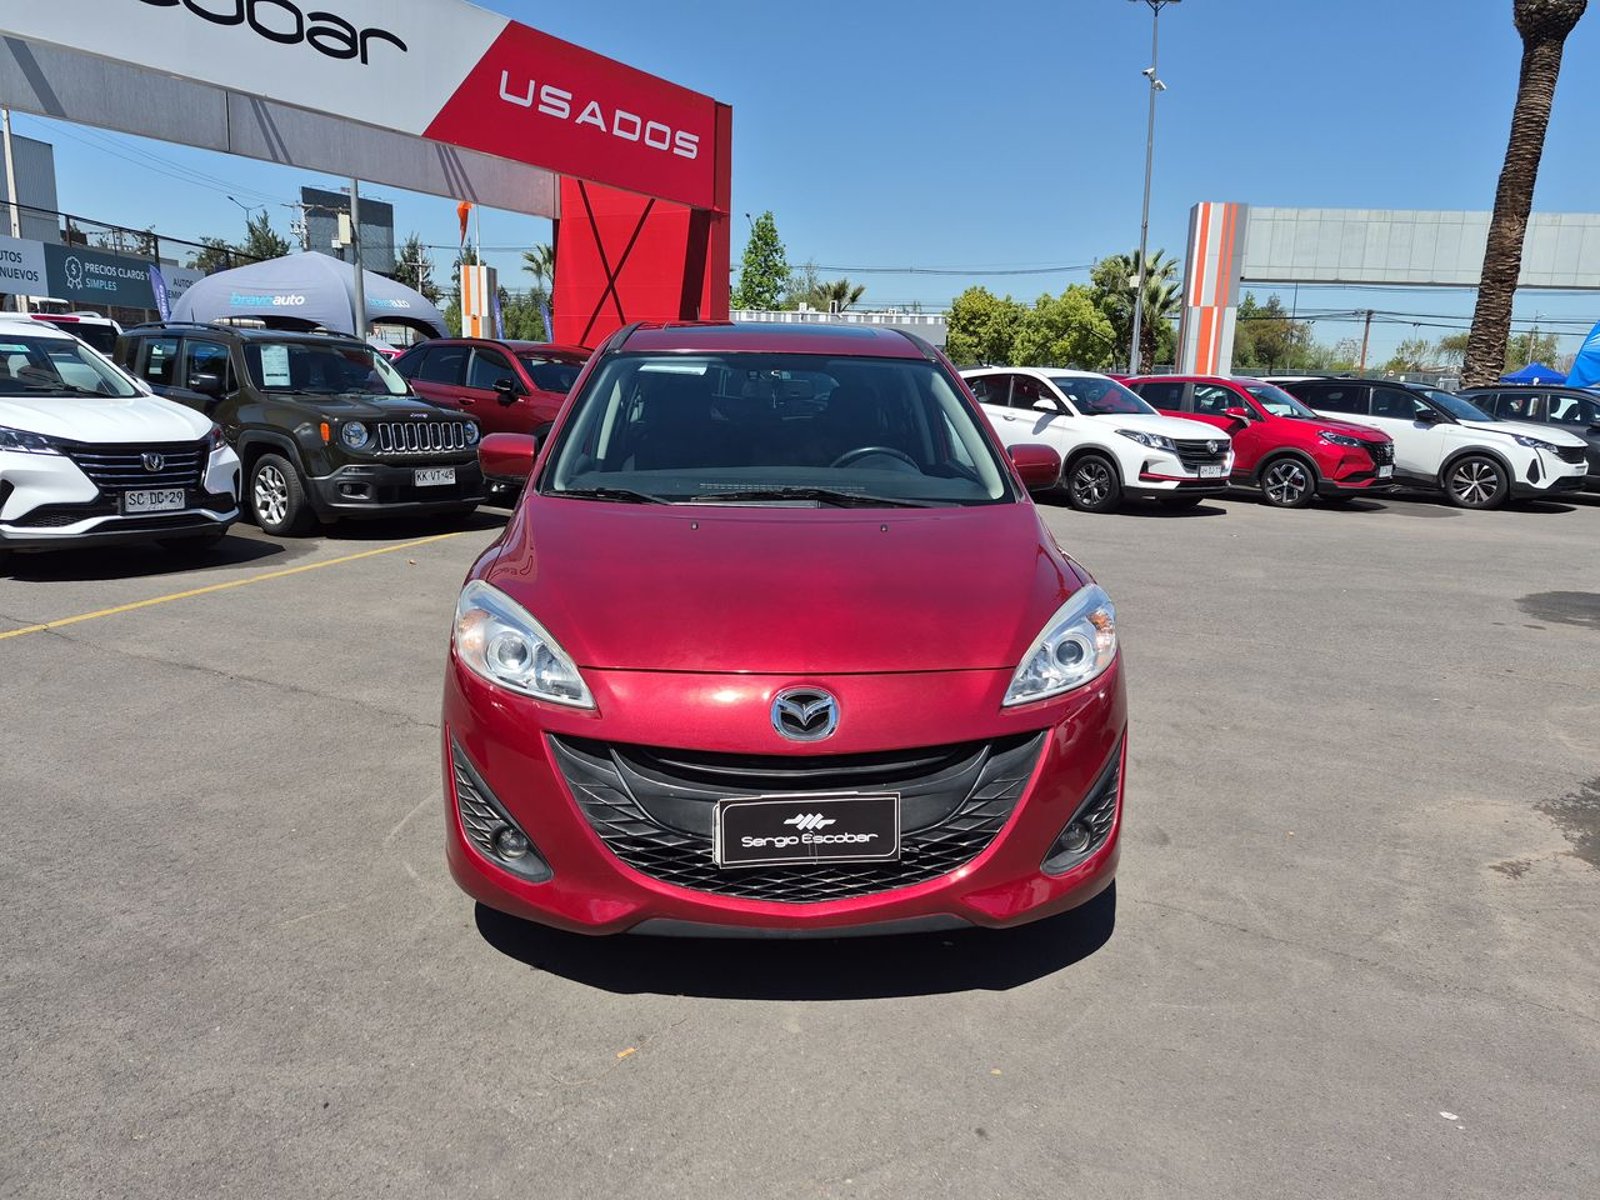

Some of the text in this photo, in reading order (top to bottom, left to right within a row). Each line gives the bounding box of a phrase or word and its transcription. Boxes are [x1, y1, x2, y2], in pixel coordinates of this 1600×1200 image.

[499, 70, 700, 160] USADOS
[84, 262, 117, 277] PRECIOS
[118, 268, 145, 280] CLAROS
[85, 278, 118, 291] SIMPLES
[230, 292, 305, 307] bravoauto
[128, 493, 145, 505] SC
[801, 832, 879, 844] Escobar
